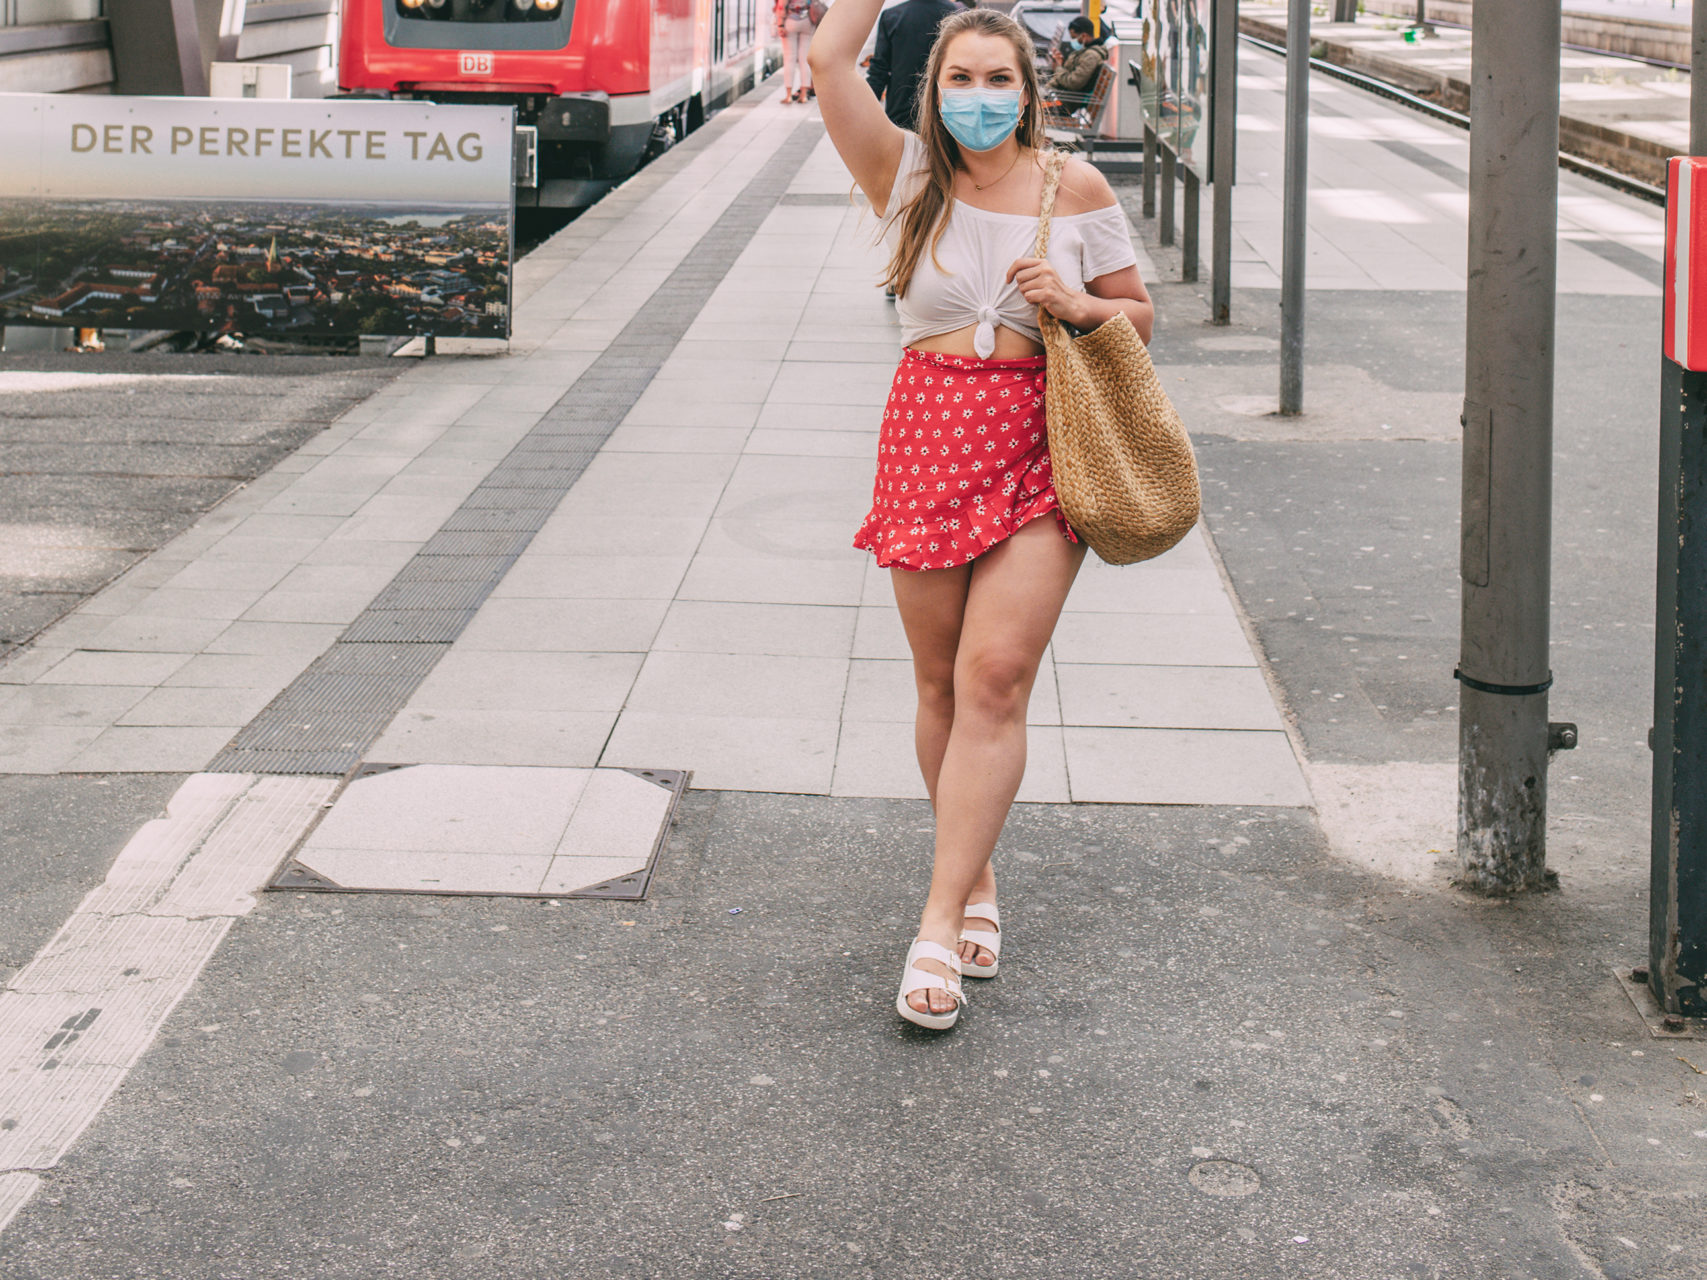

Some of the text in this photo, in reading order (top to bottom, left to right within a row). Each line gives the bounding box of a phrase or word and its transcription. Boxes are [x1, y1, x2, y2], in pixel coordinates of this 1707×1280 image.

[464, 56, 489, 72] DB
[70, 123, 484, 162] DER PERFEKTE TAG
